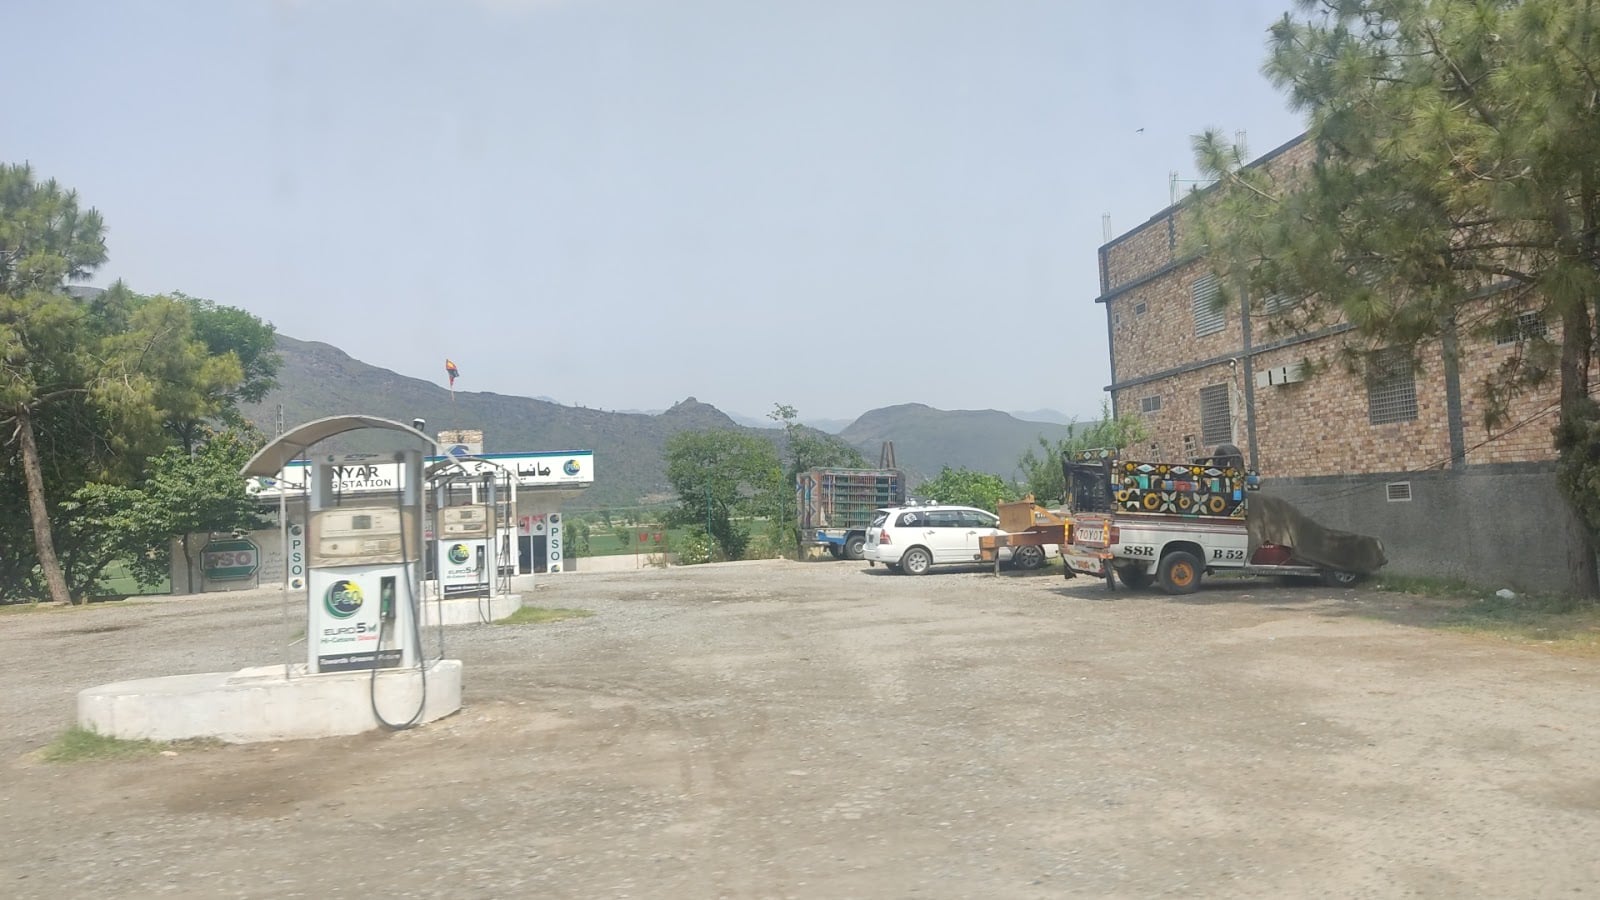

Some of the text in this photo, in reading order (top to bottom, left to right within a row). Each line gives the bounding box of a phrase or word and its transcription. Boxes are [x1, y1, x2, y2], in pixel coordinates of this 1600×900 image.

[304, 466, 379, 479] MNYAR
[341, 478, 391, 488] STATION
[1078, 529, 1104, 542] TOYOT
[551, 527, 560, 561] PSO
[1123, 545, 1155, 556] SSR
[290, 539, 302, 575] PSO
[1213, 549, 1244, 560] B 52
